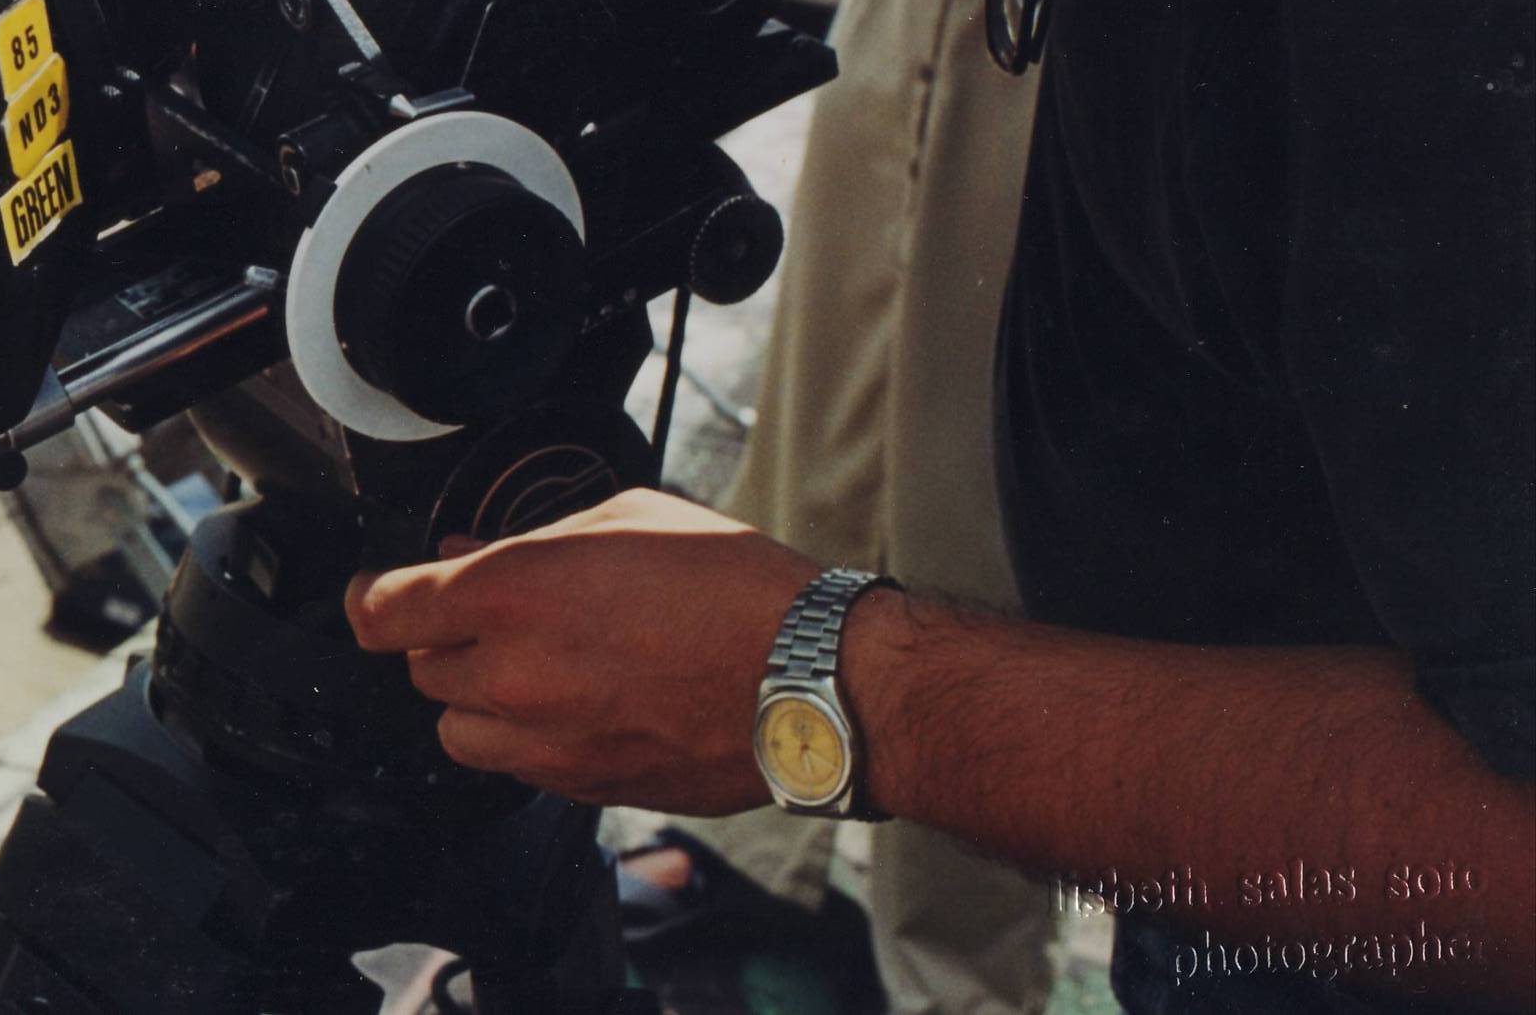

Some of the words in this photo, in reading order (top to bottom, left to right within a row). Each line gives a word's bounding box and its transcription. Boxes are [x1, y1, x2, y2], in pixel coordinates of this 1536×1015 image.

[11, 25, 40, 71] 85
[18, 82, 62, 150] ND3
[10, 152, 75, 249] GREEN
